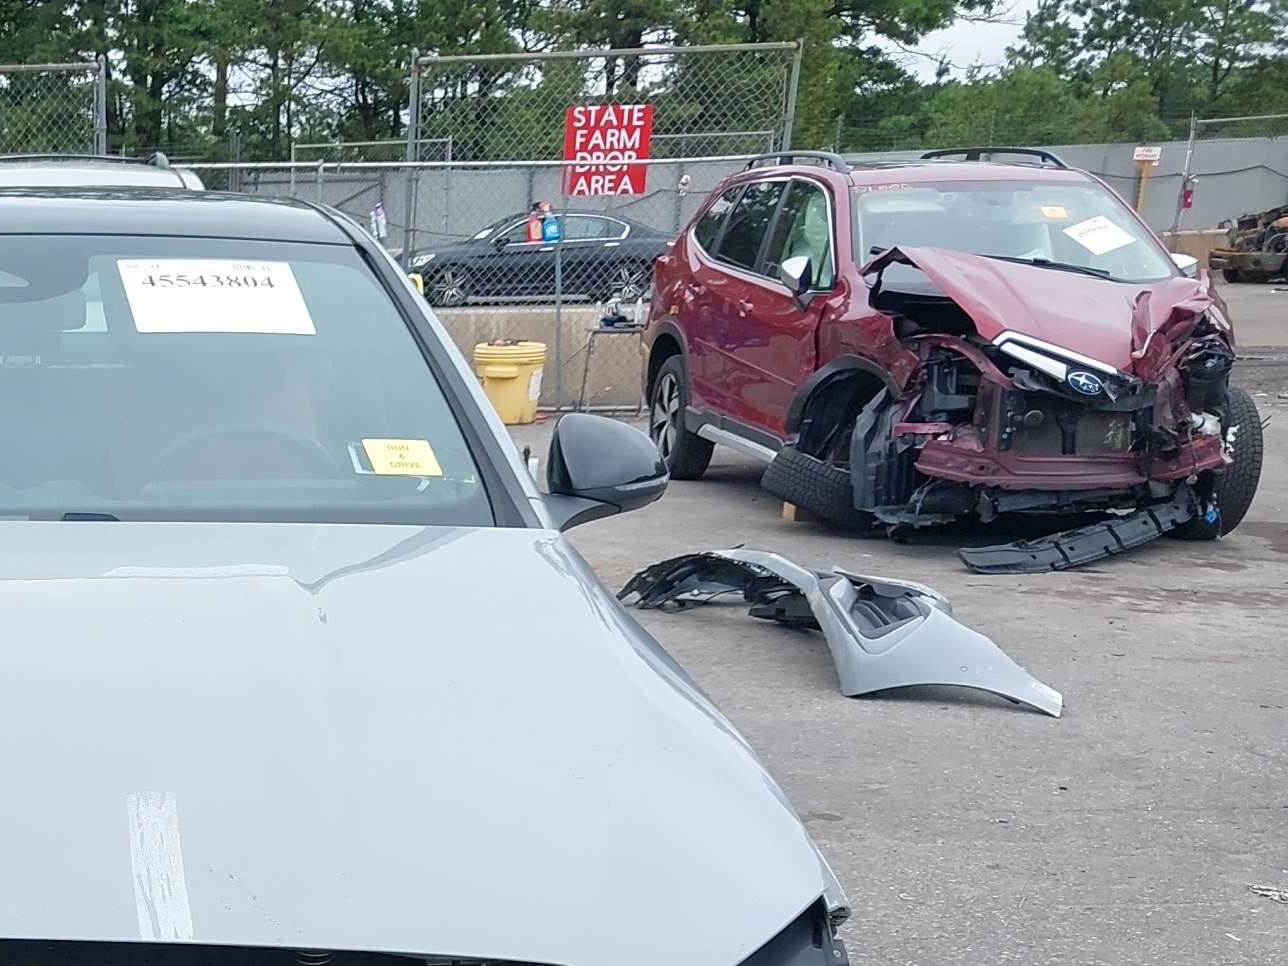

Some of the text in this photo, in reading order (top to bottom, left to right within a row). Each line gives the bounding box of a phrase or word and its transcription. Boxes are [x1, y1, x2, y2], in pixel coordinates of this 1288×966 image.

[572, 104, 646, 127] STATE
[575, 128, 641, 150] FARM
[575, 151, 638, 173] DROP
[572, 174, 634, 196] AREA
[141, 275, 275, 288] 45543804
